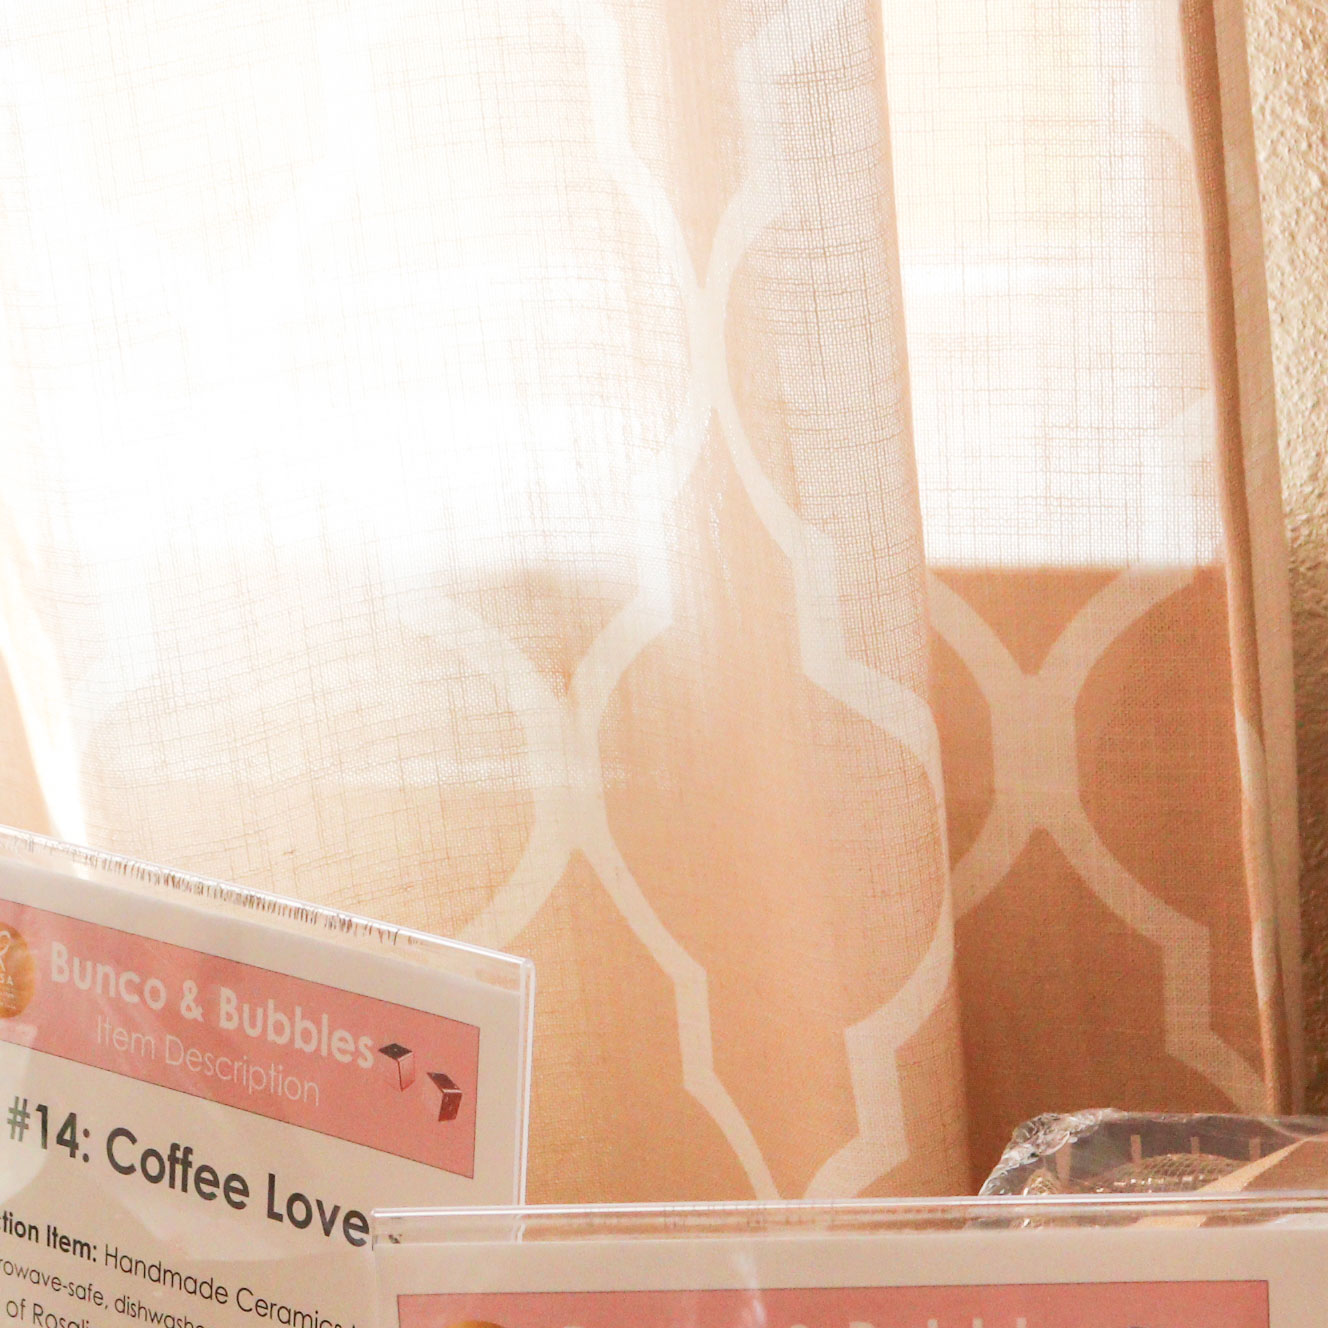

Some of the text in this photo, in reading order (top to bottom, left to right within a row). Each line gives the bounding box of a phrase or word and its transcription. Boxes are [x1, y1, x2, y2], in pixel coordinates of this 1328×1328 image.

[51, 943, 166, 1010] Bunco
[181, 980, 204, 1022] &
[219, 987, 374, 1069] Bubbles
[97, 1014, 319, 1106] Item Description
[7, 1097, 370, 1248] #14: Coffee Love
[7, 1294, 27, 1320] of
[46, 1226, 97, 1263] Item:
[105, 1244, 240, 1306] Handmade
